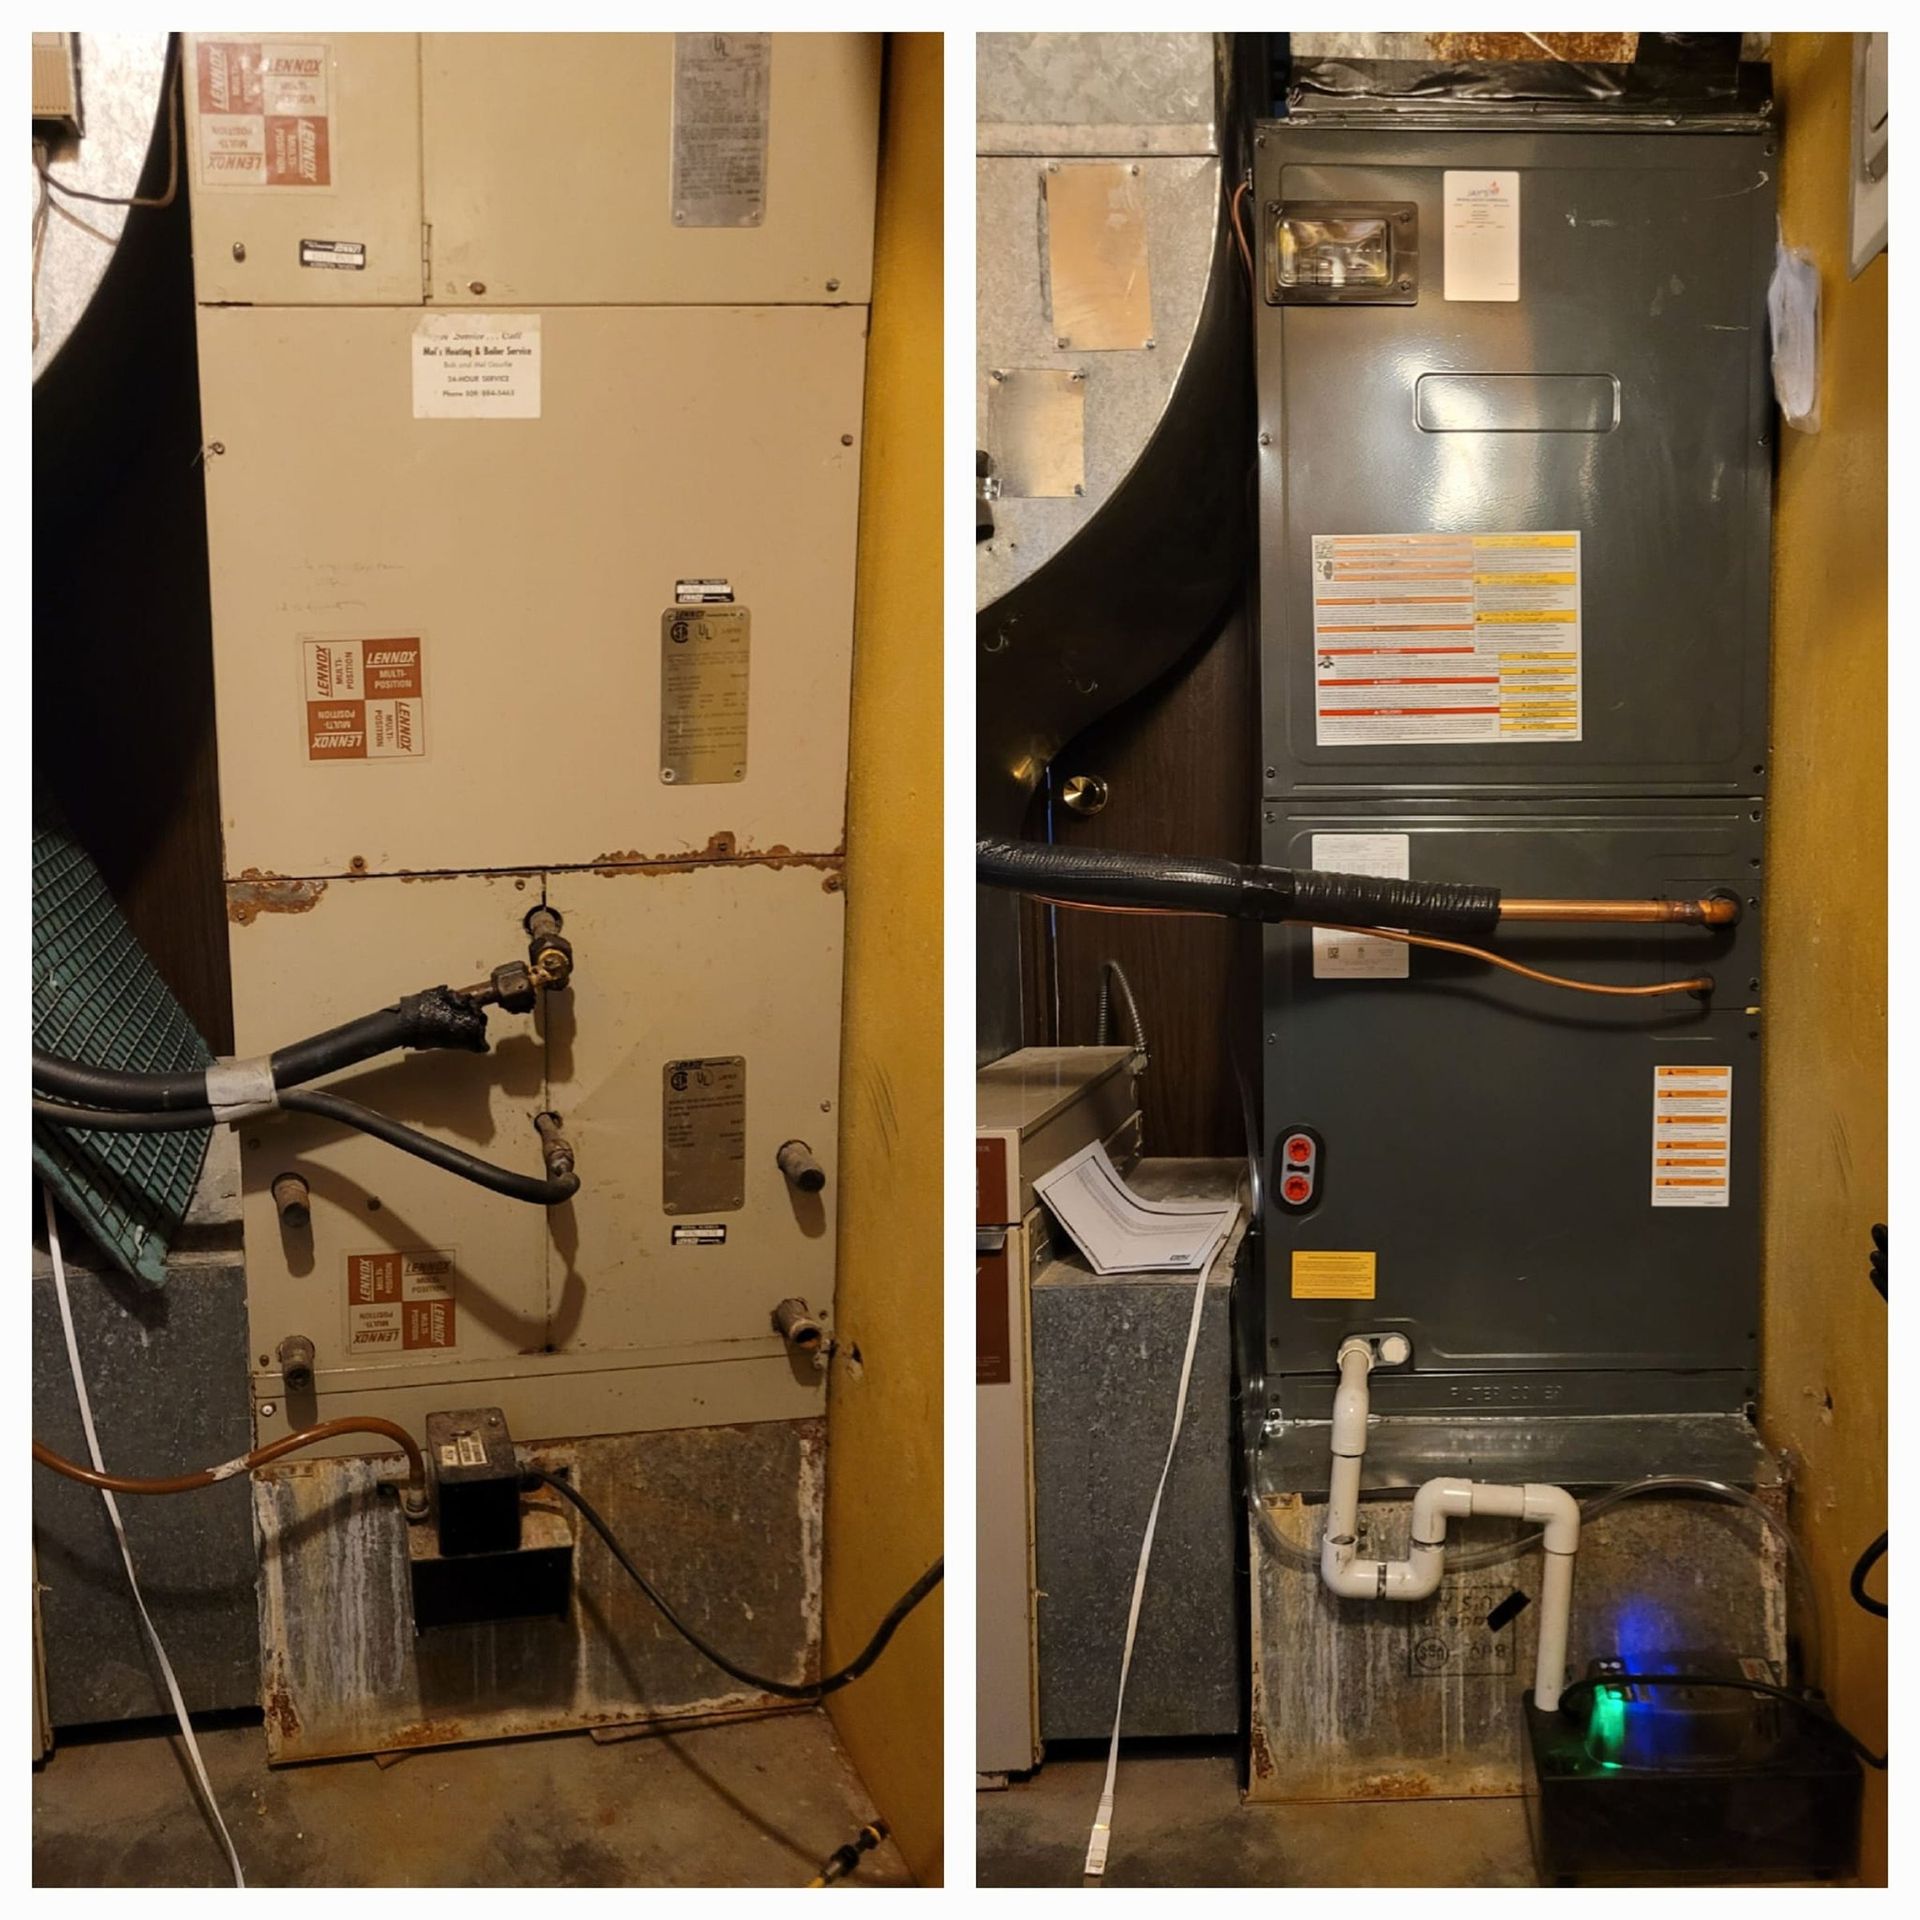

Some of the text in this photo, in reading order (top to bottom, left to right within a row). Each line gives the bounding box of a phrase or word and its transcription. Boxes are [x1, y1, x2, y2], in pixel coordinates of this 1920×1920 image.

[268, 59, 322, 73] LENNOX
[209, 46, 227, 112] LENNOX
[301, 118, 317, 183] LENNOX
[207, 155, 262, 170] LENNOX
[445, 346, 472, 358] Heating
[475, 346, 481, 356] &
[507, 346, 532, 356] Service
[482, 375, 509, 383] SERVICE
[367, 651, 418, 664] LENNOX
[316, 645, 329, 697] LENNOX
[335, 657, 343, 685] MULTI-
[345, 652, 354, 690] POSITION
[379, 669, 407, 678] MULTI-
[375, 680, 412, 689] POSITION
[318, 710, 355, 719] POSITION
[323, 721, 351, 729] MULTI-
[375, 710, 384, 747] POSITION
[386, 714, 394, 742] MULTI-
[399, 702, 412, 752] LENNOX
[312, 735, 362, 748] LENNOX
[405, 1261, 451, 1273] LENNOX
[360, 1258, 371, 1302] LENNOX
[385, 1262, 393, 1294] POSITION
[433, 1303, 445, 1346] LENNOX
[353, 1332, 399, 1344] LENNOX
